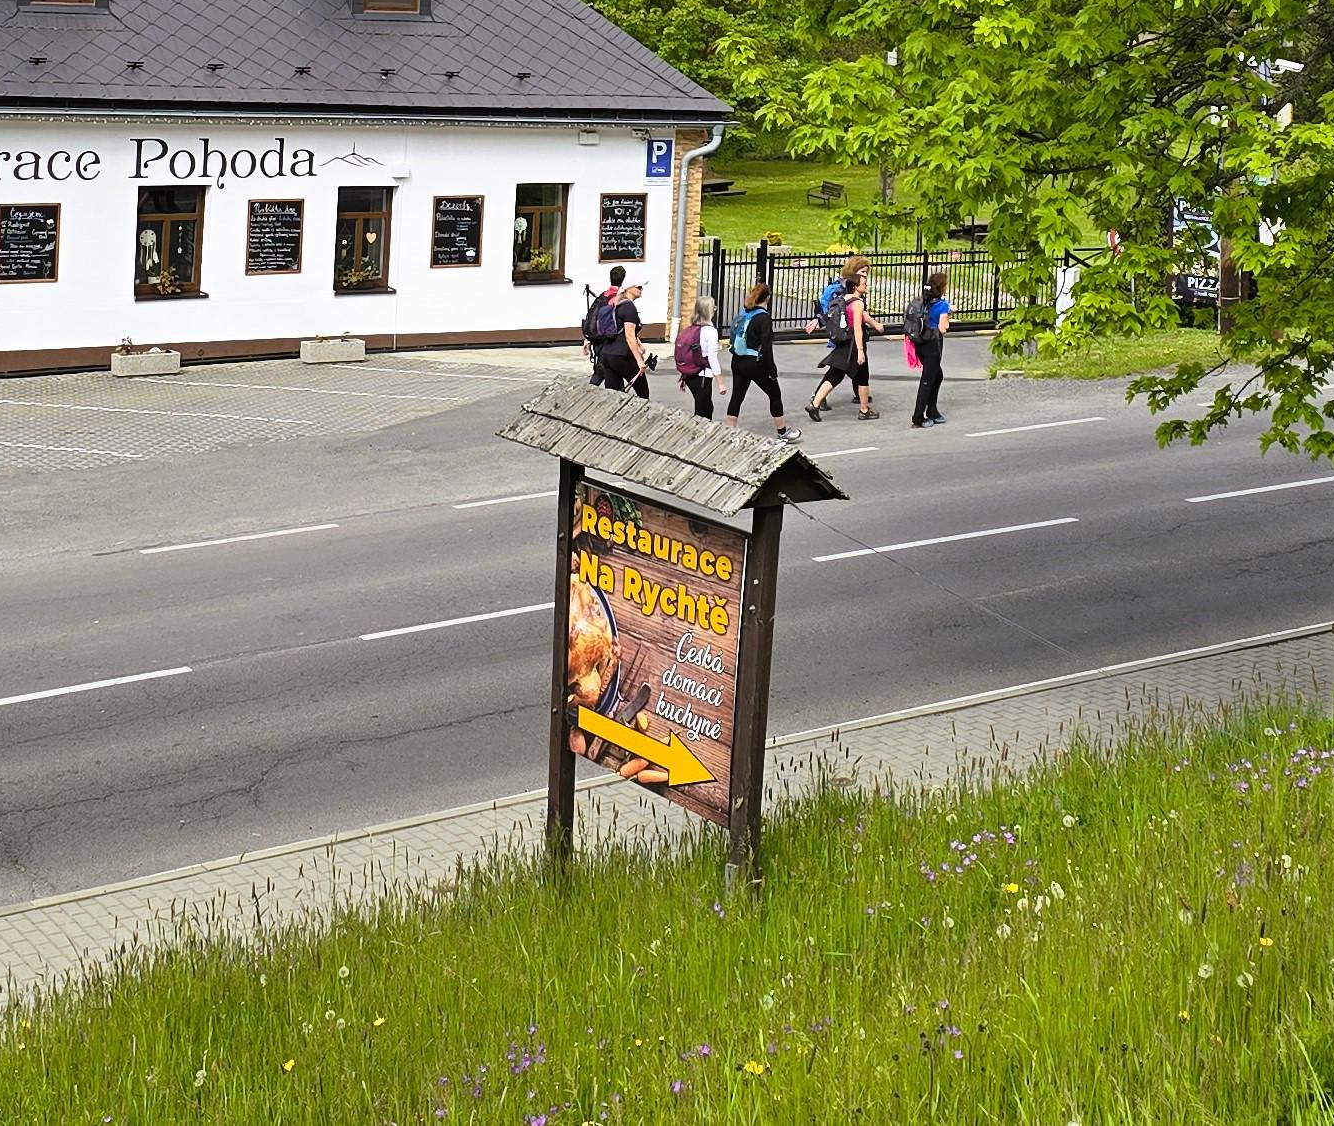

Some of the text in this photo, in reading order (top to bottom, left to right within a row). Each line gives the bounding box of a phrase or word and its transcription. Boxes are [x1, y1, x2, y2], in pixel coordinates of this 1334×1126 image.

[128, 137, 318, 189] Pohoda
[652, 141, 667, 163] P
[581, 502, 734, 581] Restaurace
[578, 550, 731, 636] Na Rychtě
[675, 629, 725, 675] Česká
[661, 665, 724, 708] domácí
[654, 694, 723, 742] kuchyně
